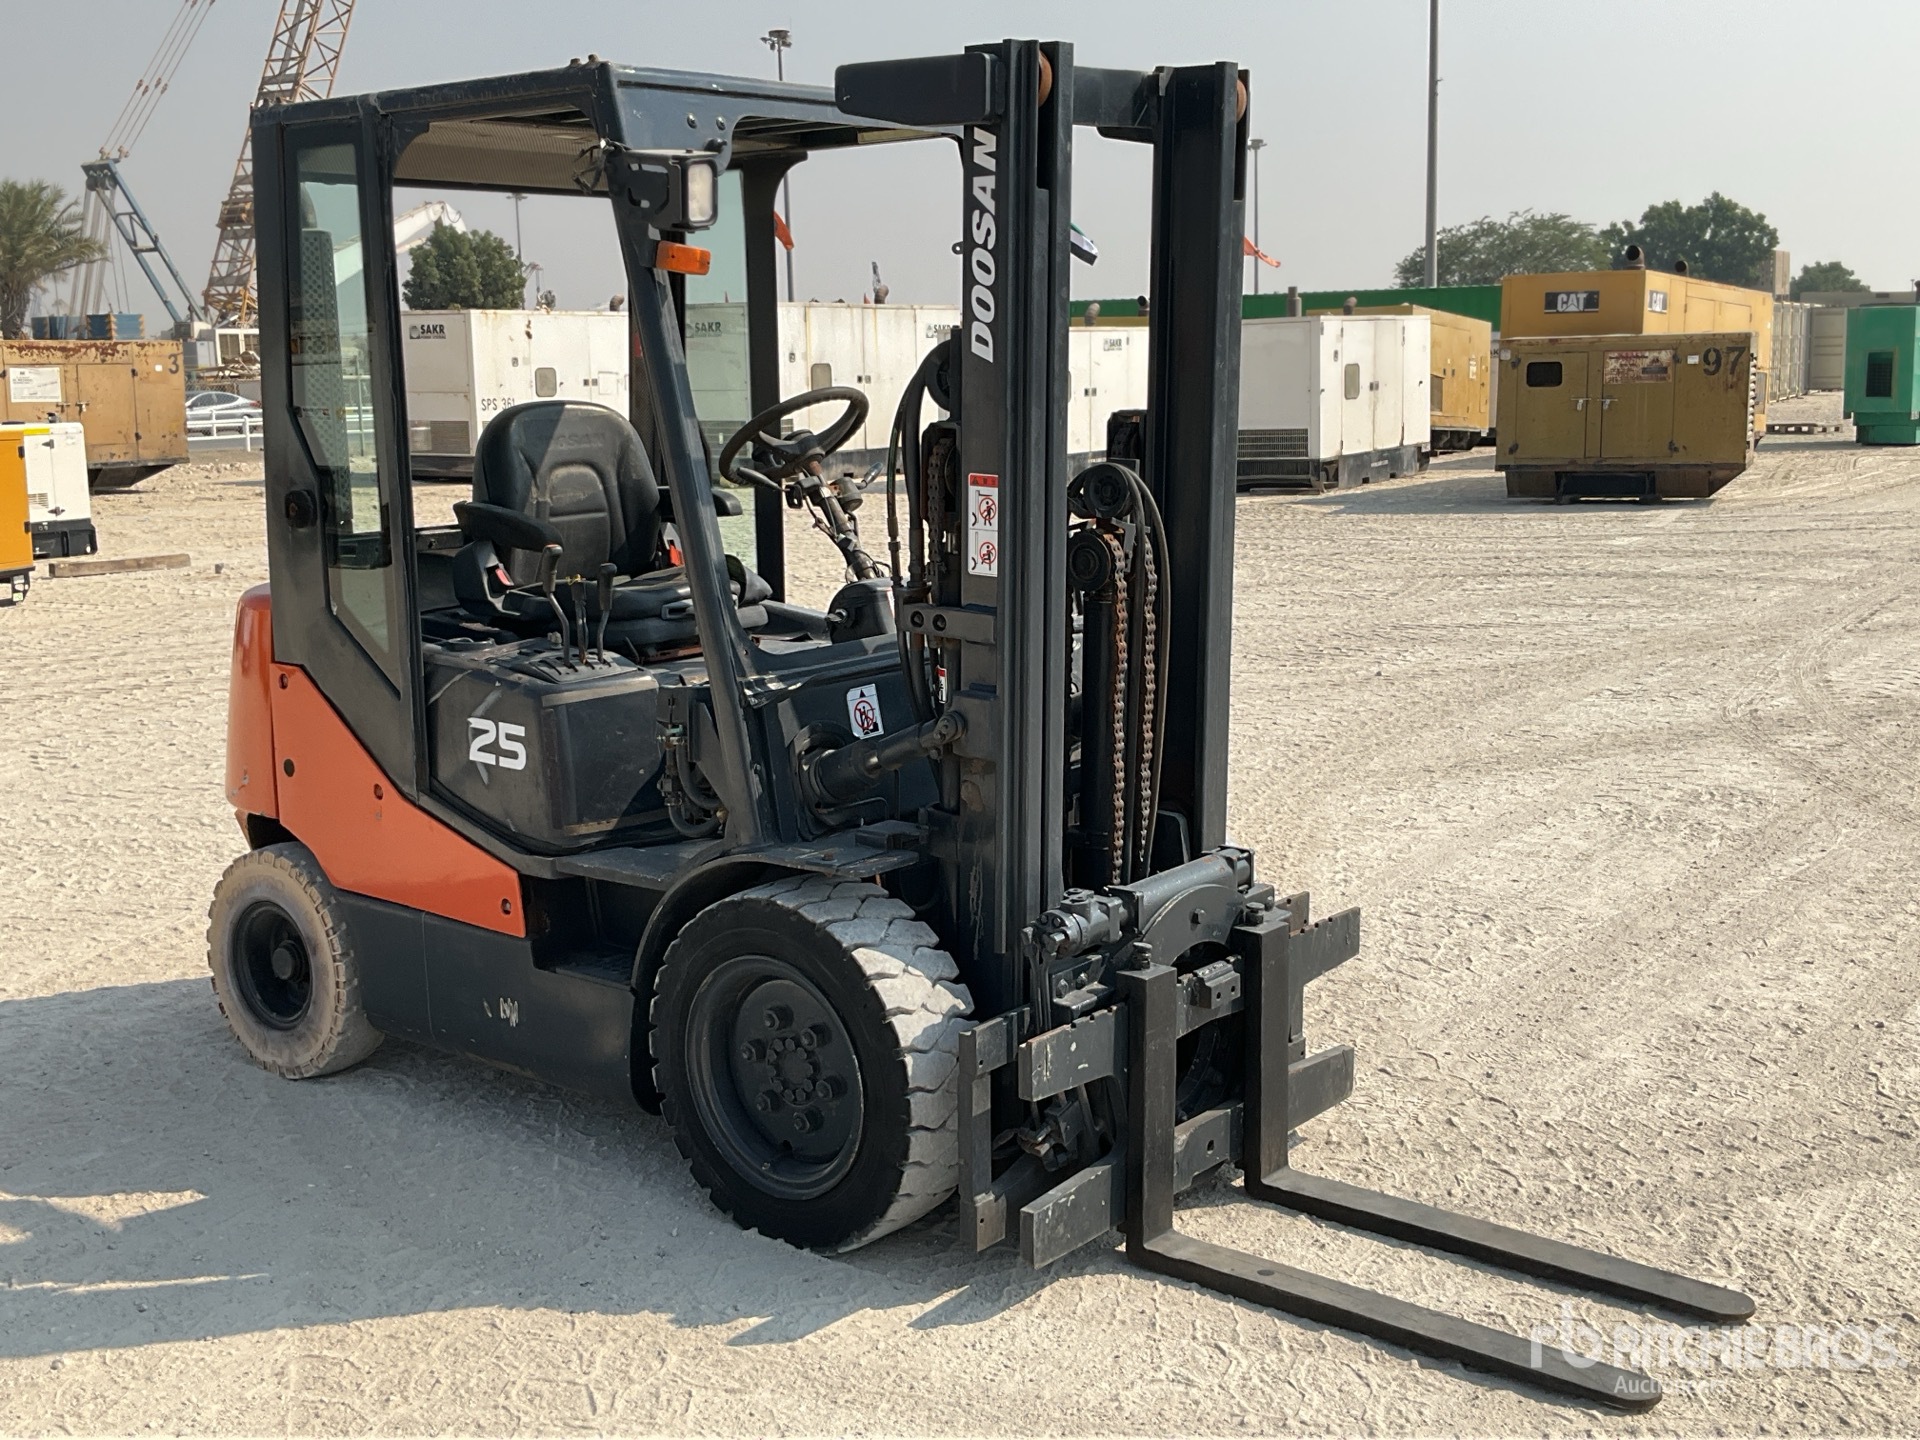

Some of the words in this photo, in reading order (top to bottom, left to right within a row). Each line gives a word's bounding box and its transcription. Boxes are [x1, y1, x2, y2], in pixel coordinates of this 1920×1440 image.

[971, 126, 997, 364] DOOSAN
[1557, 292, 1588, 313] CAT
[1651, 291, 1664, 312] CAT
[420, 324, 446, 335] SAKR
[694, 321, 722, 333] SAKR
[168, 353, 180, 375] 3
[1703, 346, 1747, 376] 97
[481, 398, 498, 411] SPS
[467, 717, 527, 771] 25
